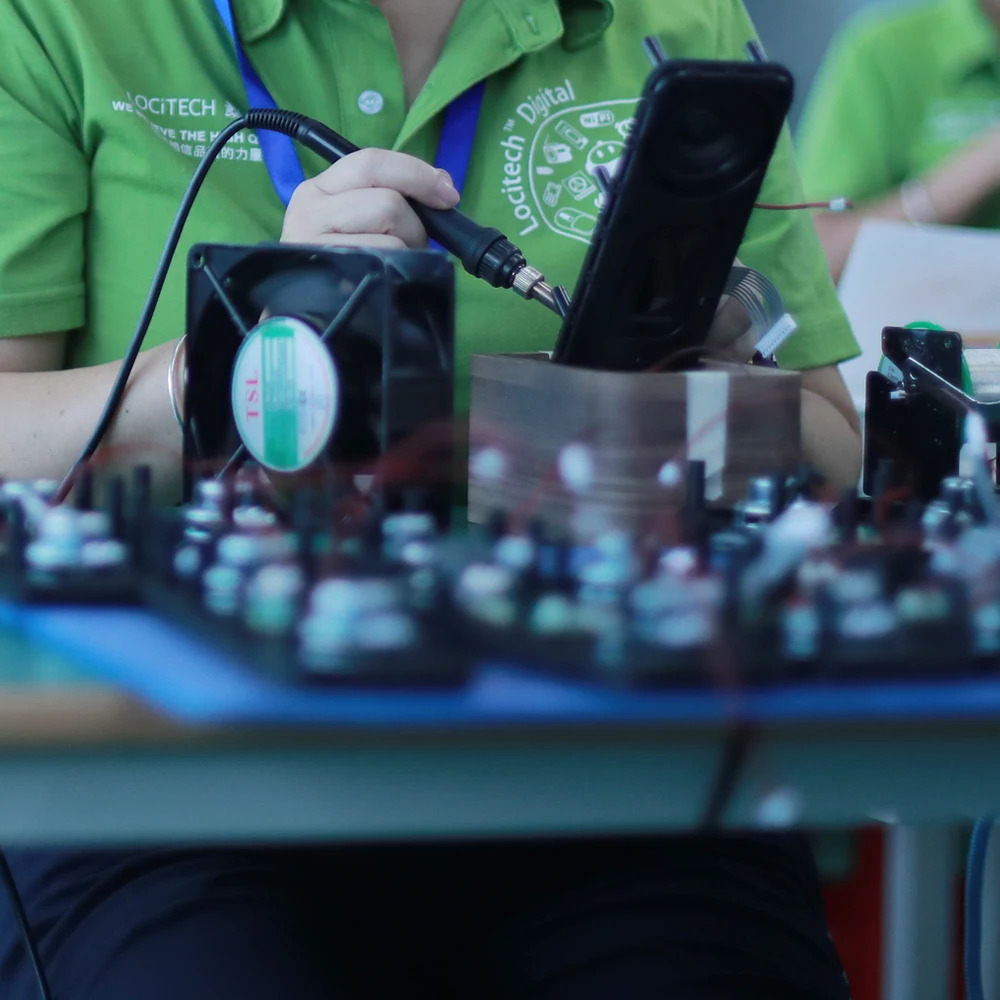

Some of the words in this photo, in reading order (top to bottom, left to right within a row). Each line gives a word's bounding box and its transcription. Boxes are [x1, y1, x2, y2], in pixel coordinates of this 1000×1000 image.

[516, 79, 576, 125] Digital
[179, 130, 206, 142] THE
[244, 369, 260, 424] TSL
